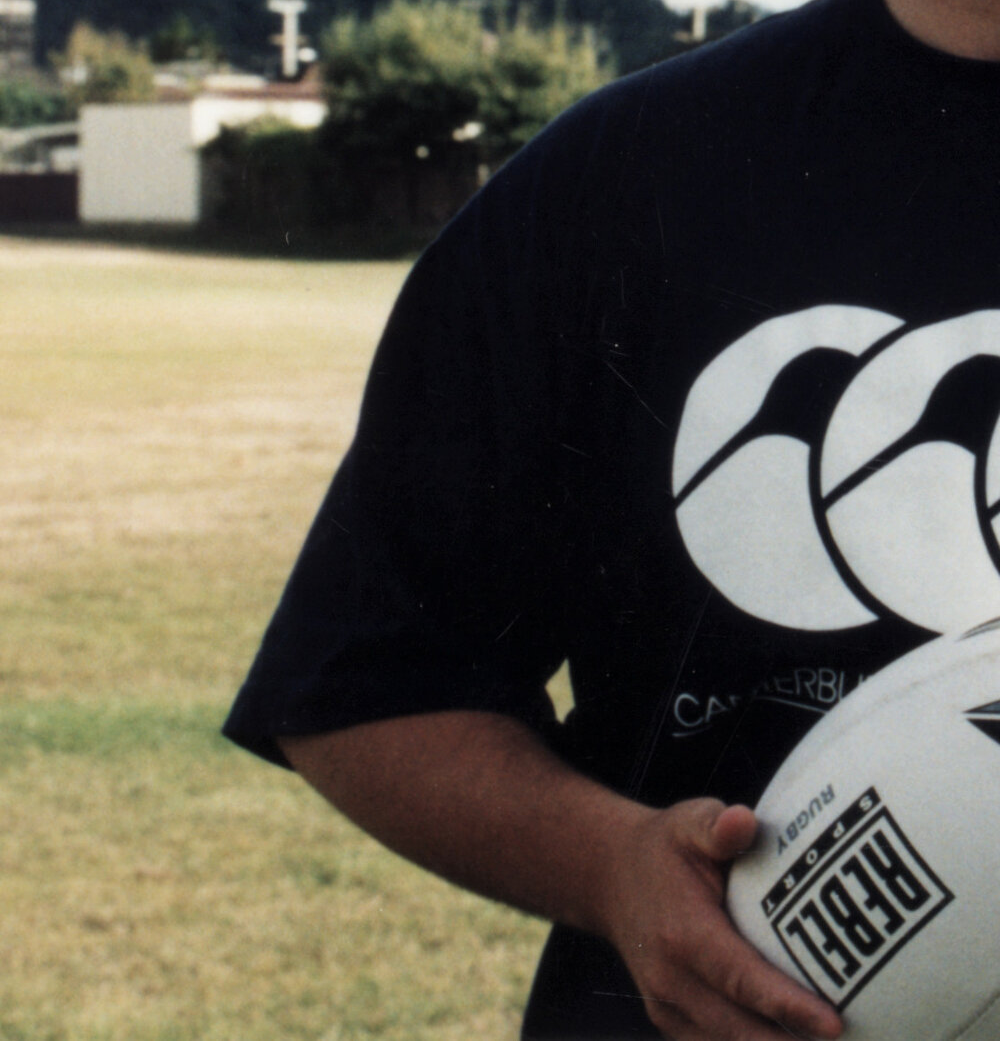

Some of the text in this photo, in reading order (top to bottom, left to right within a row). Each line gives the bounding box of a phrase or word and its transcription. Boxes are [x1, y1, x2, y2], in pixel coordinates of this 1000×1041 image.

[766, 794, 874, 910] SPORT
[776, 783, 837, 855] RUGBY
[785, 829, 932, 989] REBEL
